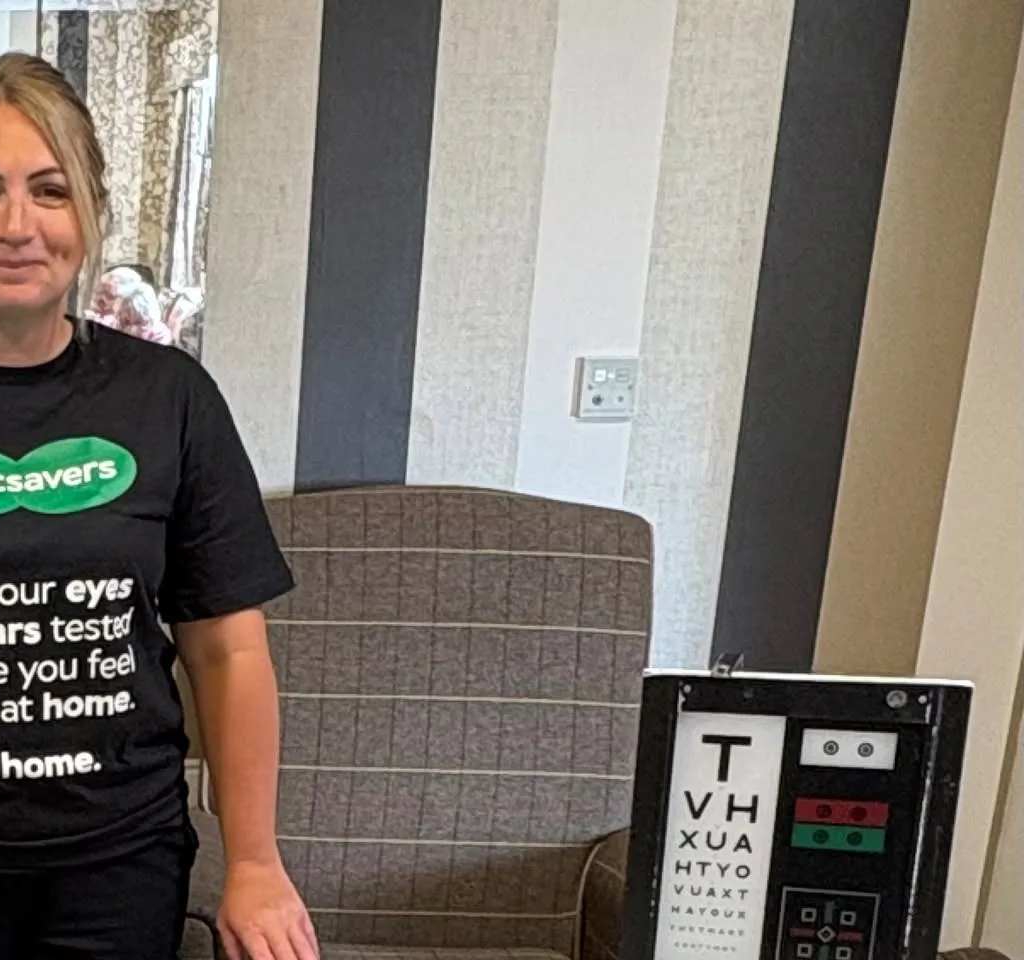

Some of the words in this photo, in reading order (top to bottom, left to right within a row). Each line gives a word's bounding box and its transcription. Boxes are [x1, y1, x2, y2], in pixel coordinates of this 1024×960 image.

[65, 577, 134, 609] eyes
[50, 606, 134, 643] tested
[17, 656, 77, 690] you
[88, 645, 135, 679] feel
[0, 695, 34, 722] at
[42, 691, 135, 721] home.
[1, 751, 102, 779] home.
[702, 734, 752, 782] T
